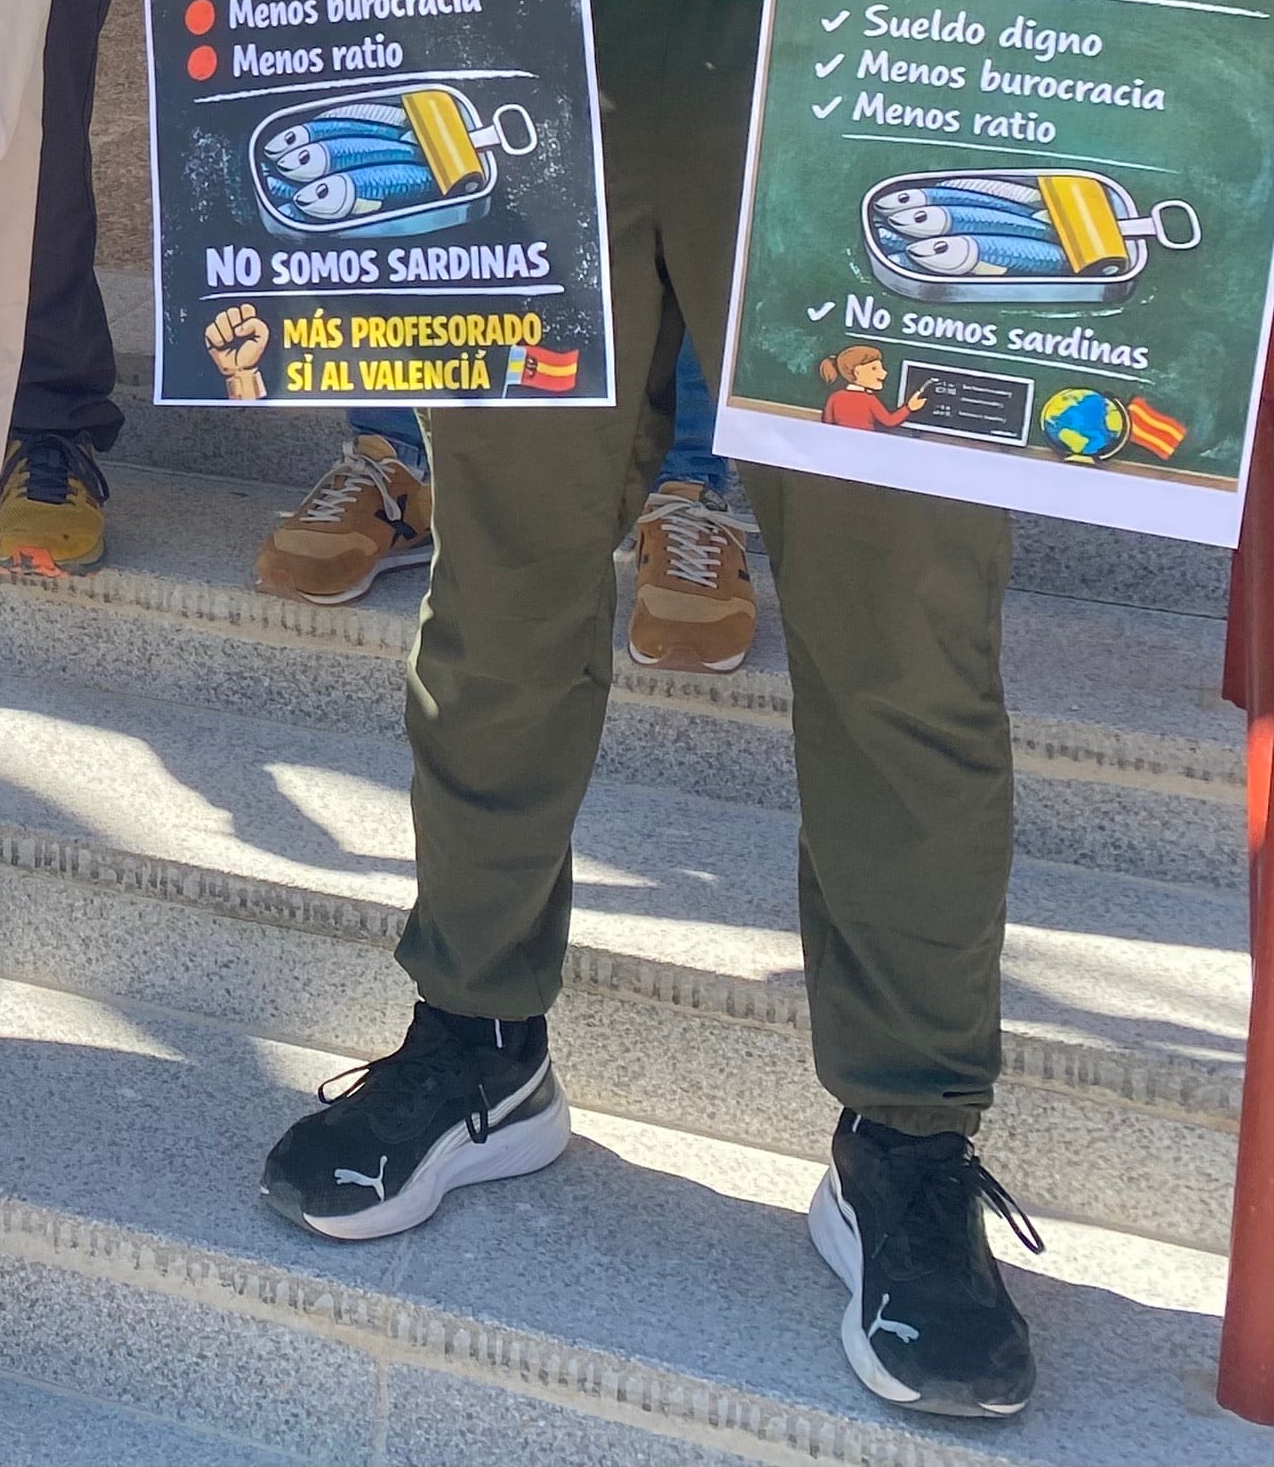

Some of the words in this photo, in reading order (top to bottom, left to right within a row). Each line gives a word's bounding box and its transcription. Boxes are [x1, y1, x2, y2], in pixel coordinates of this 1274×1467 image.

[232, 42, 324, 78] Menos
[332, 34, 403, 71] ratio
[863, 4, 985, 46] Sueldo
[998, 15, 1103, 62] digno
[857, 49, 966, 88] Menos
[979, 59, 1166, 111] burocracia
[852, 91, 961, 133] Menos
[973, 107, 1057, 144] ratio
[205, 244, 261, 287] NO
[271, 249, 380, 286] SOMOS
[388, 241, 550, 282] SARDINAS
[283, 308, 343, 349] MÁS
[351, 312, 542, 349] PROFESORADO
[845, 294, 892, 331] No
[901, 311, 997, 346] somos
[1008, 326, 1150, 370] sardinas
[320, 361, 354, 391] AL
